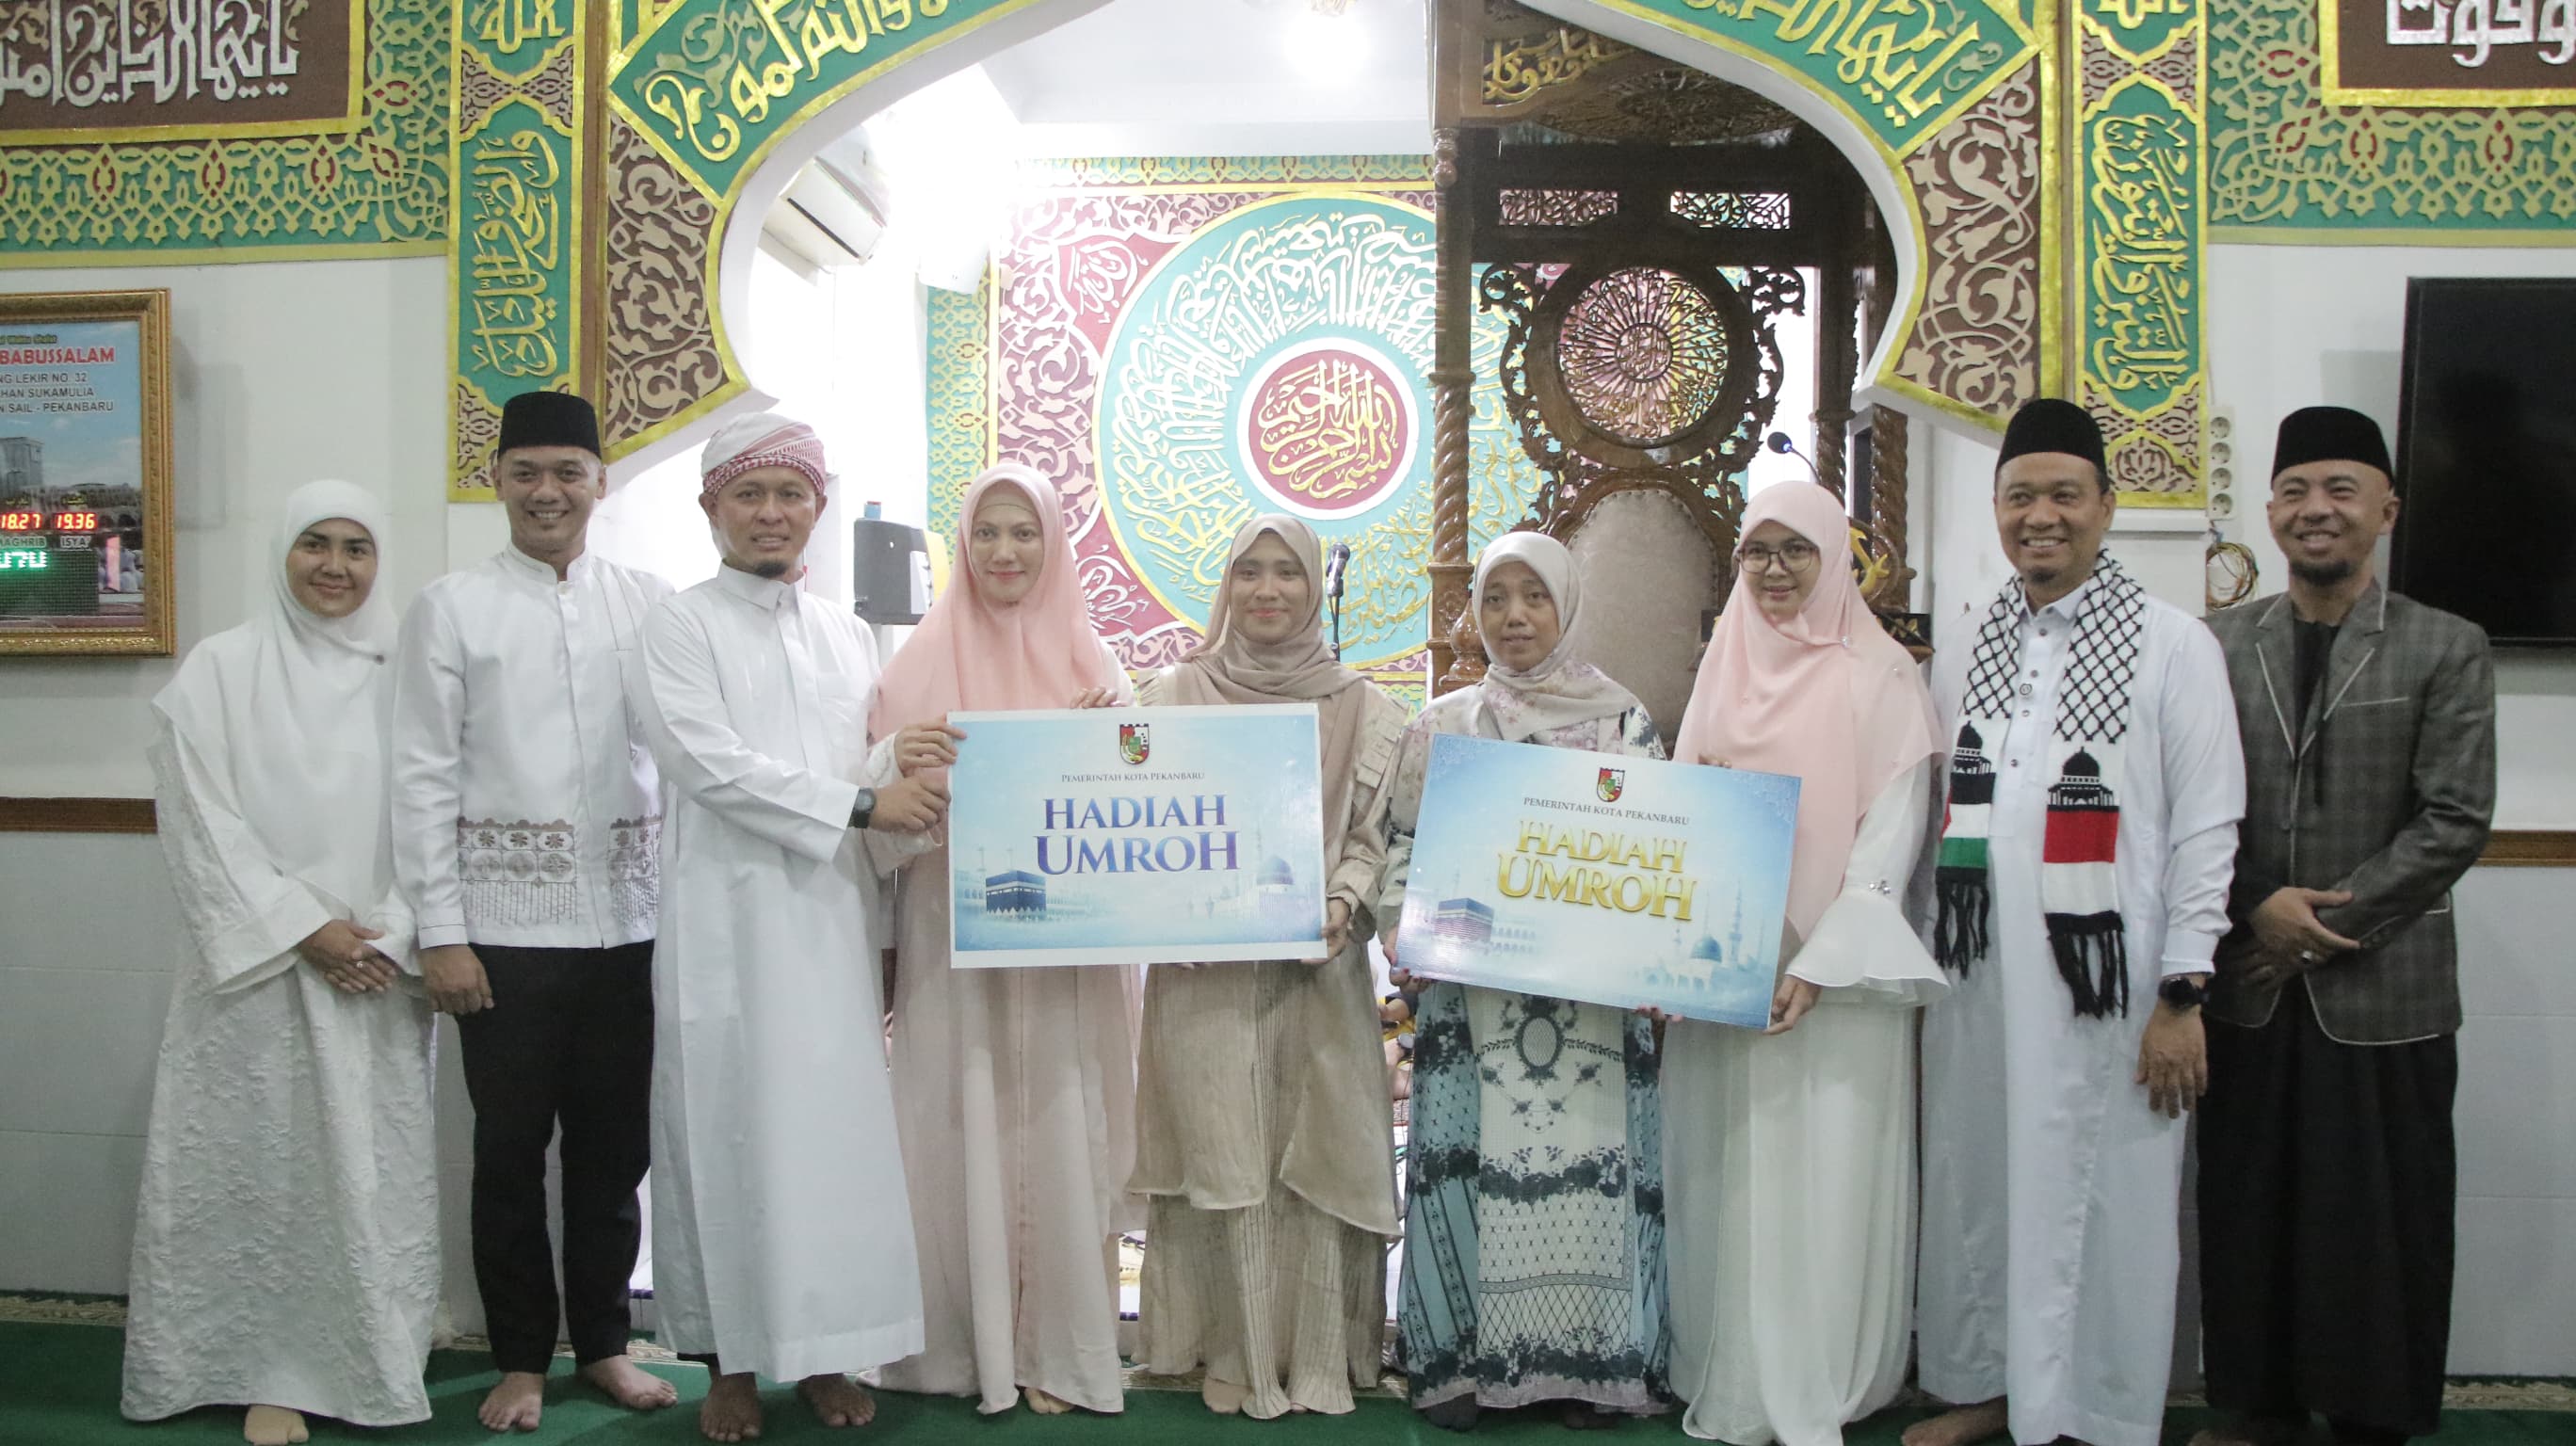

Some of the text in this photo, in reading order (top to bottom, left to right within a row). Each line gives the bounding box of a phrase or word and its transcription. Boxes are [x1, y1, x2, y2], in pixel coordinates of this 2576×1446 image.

[0, 347, 115, 365] BABUSSALAM
[16, 374, 48, 384] LEKIR
[74, 372, 88, 382] 32
[28, 387, 94, 398] SUKAMULIA
[8, 403, 33, 413] SAIL
[43, 401, 114, 412] PEKANBARU
[1061, 771, 1205, 783] PEMERINTAH KOTA PEKANBARU
[1044, 795, 1228, 830] HADIAH
[1523, 796, 1690, 826] PEMERINTAH KOTA PEKANBARU
[1033, 831, 1241, 876] UMROH
[1516, 820, 1687, 874] HADIAH
[1497, 852, 1698, 921] UMROH
